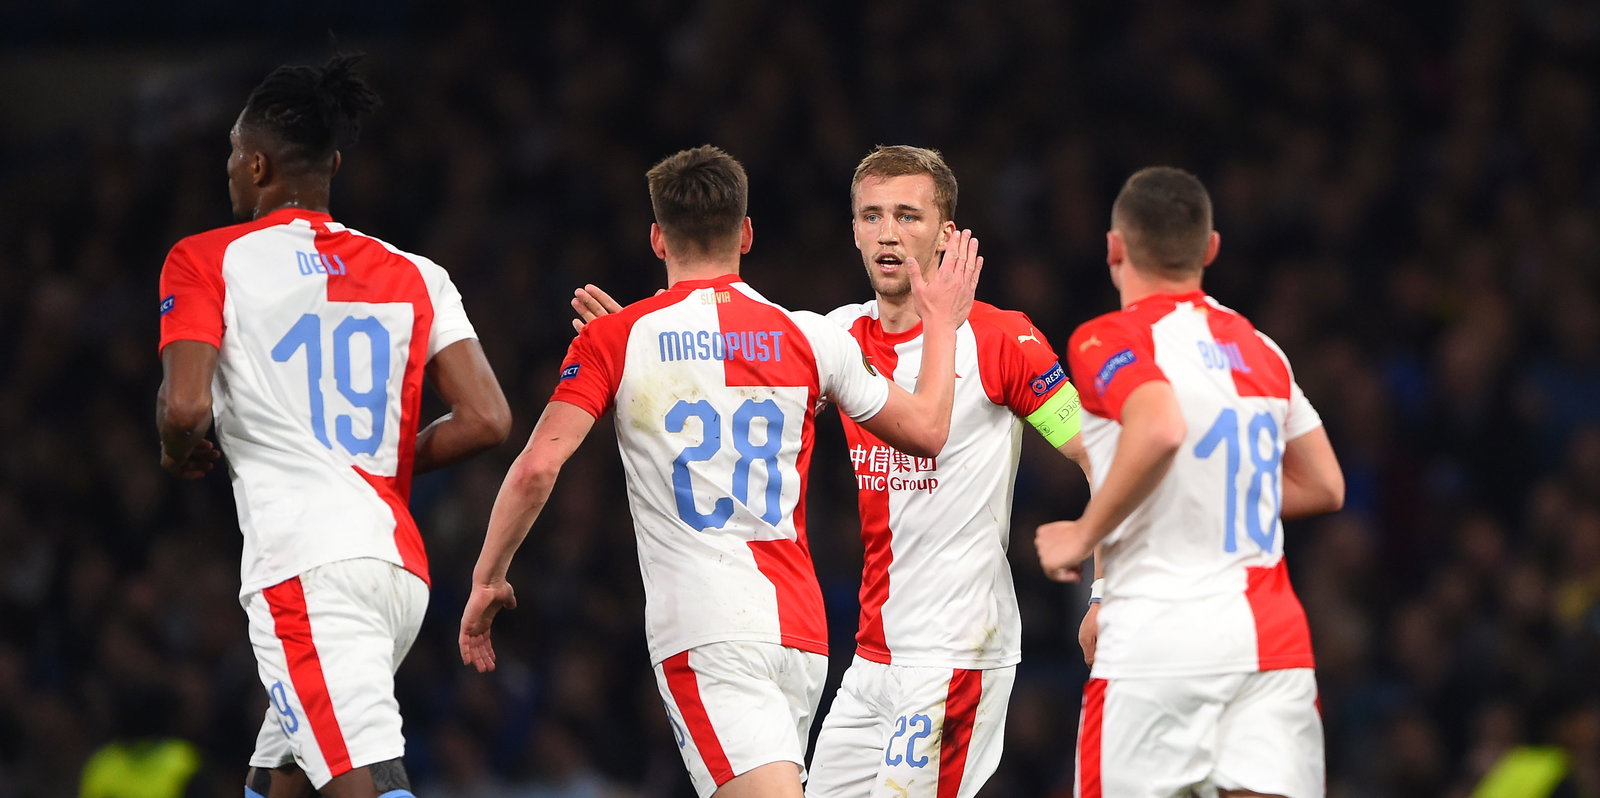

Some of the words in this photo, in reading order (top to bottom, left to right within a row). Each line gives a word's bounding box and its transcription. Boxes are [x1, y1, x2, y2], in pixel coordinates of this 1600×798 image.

[296, 250, 346, 275] DELI
[700, 291, 731, 305] SLAVIA
[658, 330, 783, 362] MASOPUST
[270, 313, 390, 457] 19
[561, 366, 579, 378] ECT
[664, 398, 785, 533] 28
[849, 443, 938, 474] 中信集团
[855, 473, 886, 492] ITIC
[889, 476, 939, 495] Group
[1193, 407, 1281, 554] 18
[885, 713, 932, 769] 22
